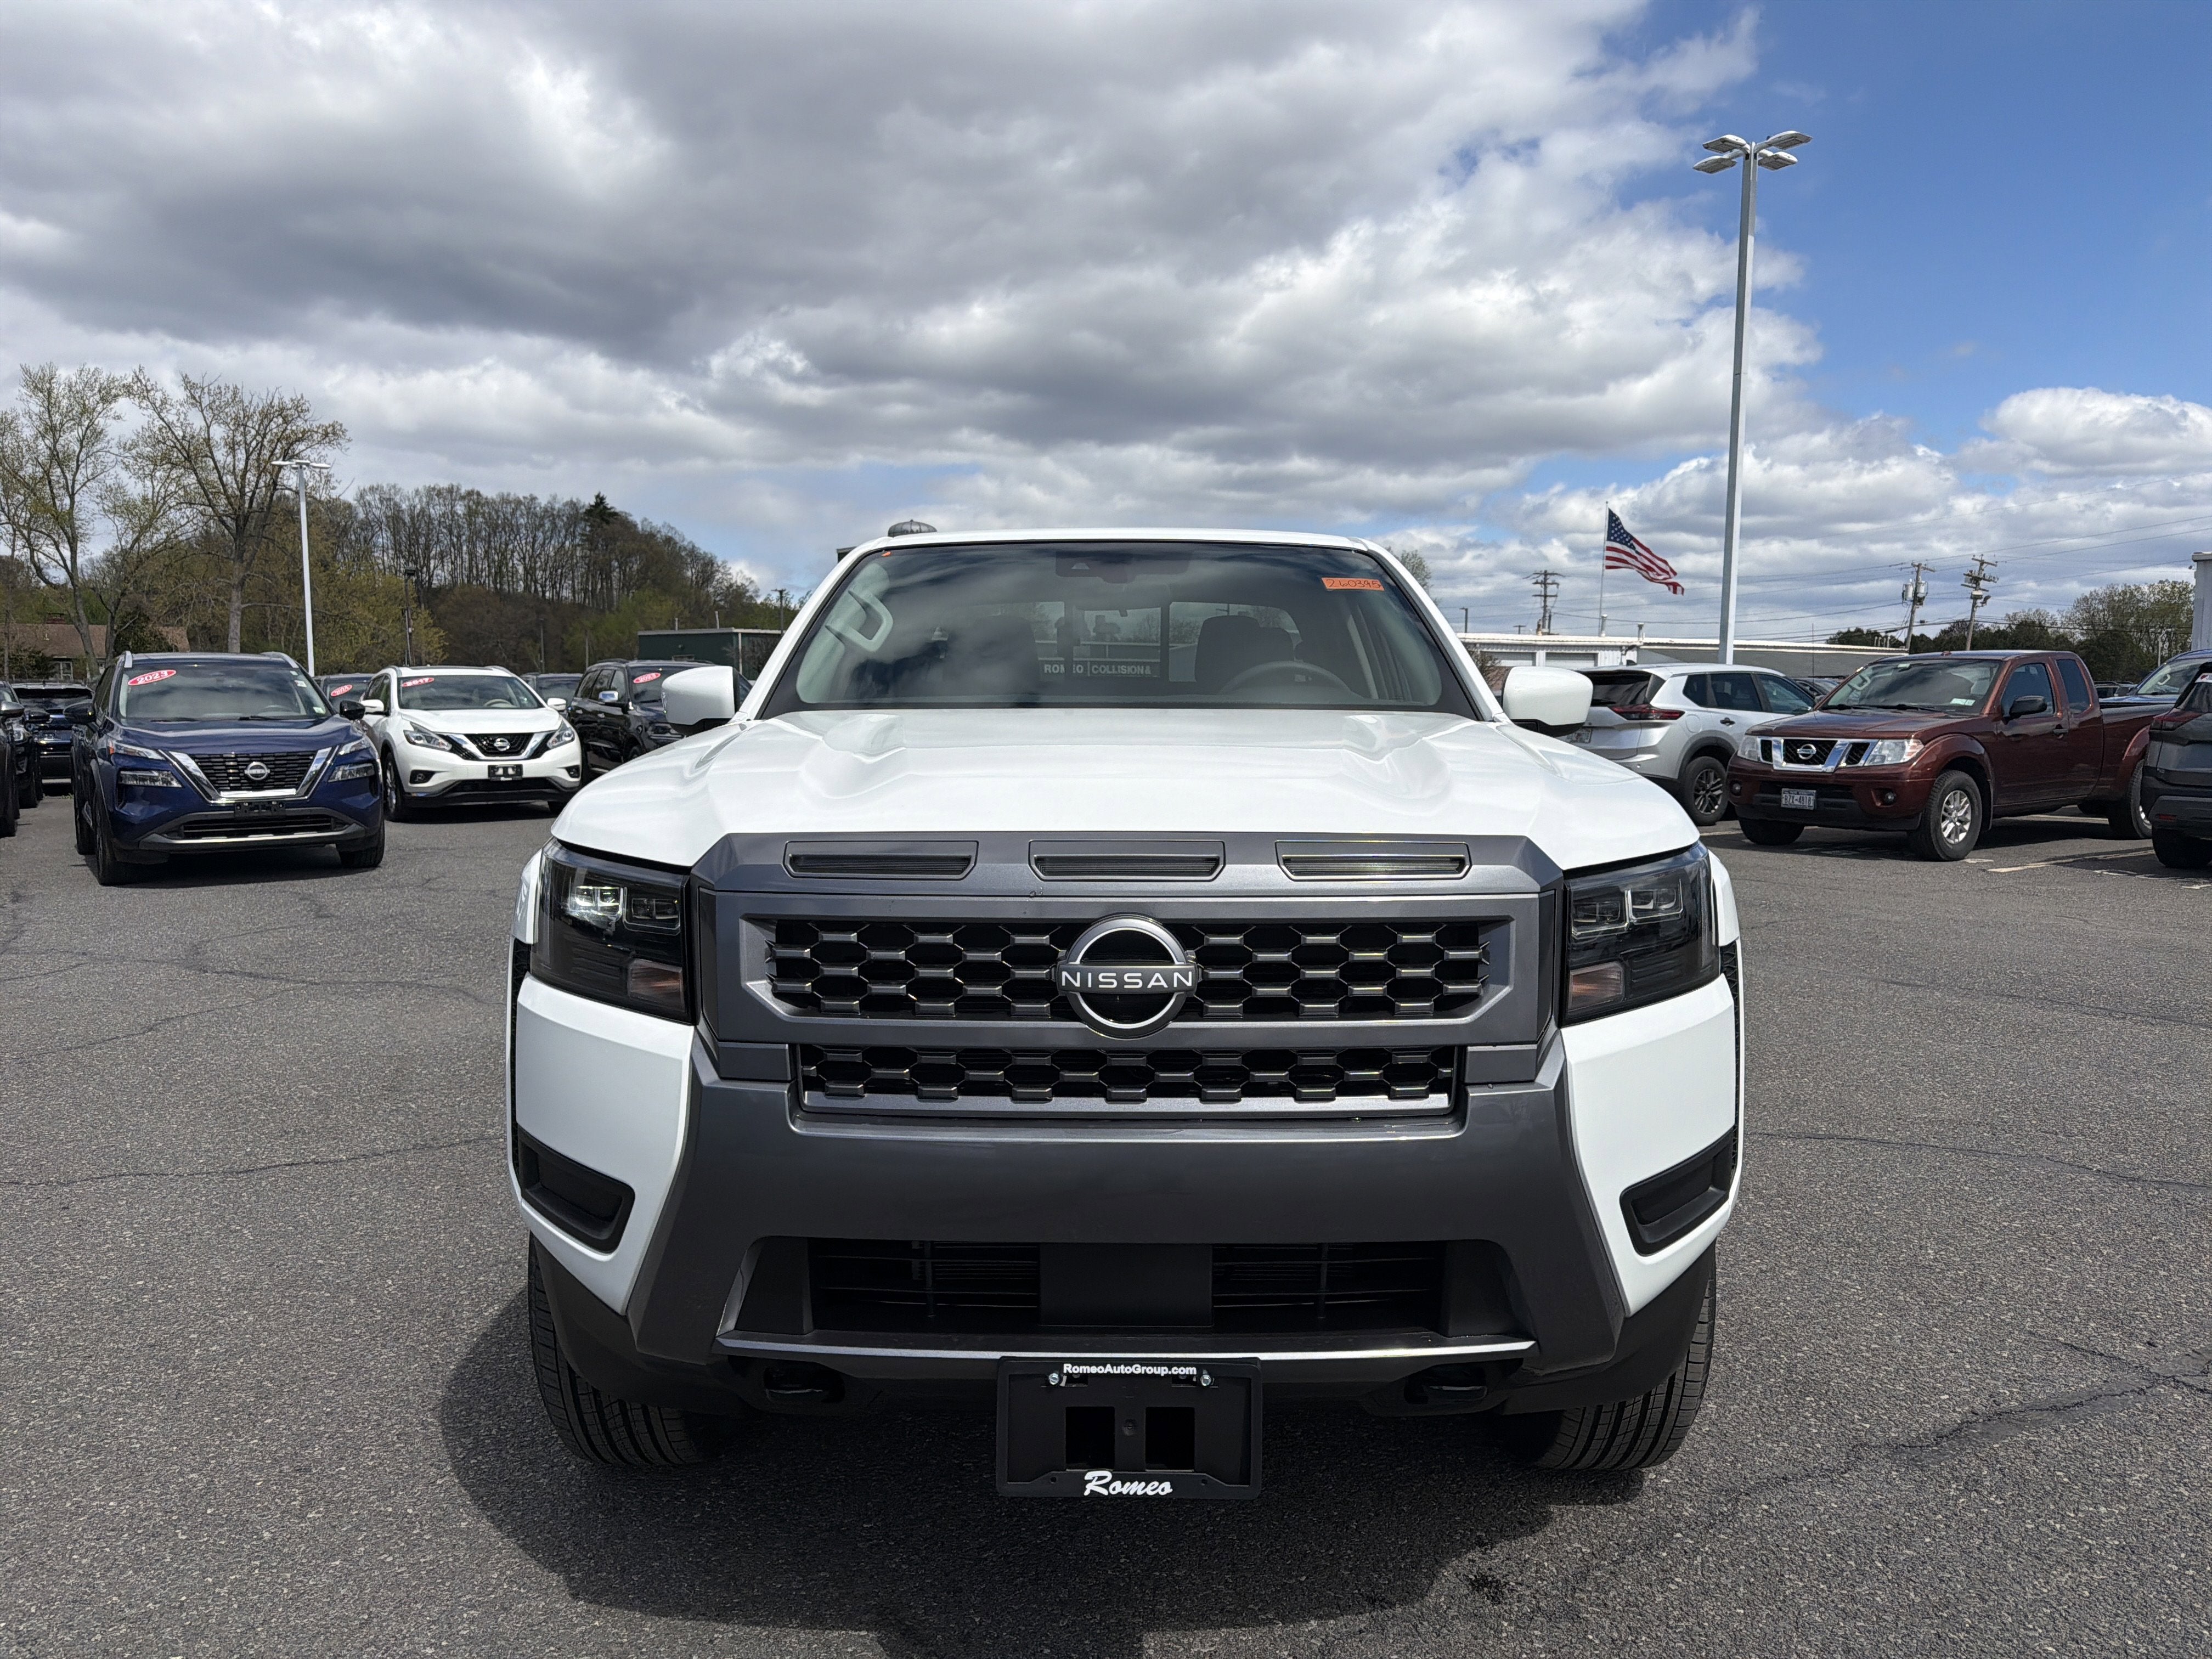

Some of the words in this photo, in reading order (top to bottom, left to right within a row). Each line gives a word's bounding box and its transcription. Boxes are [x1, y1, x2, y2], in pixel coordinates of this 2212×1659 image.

[1326, 579, 1381, 588] 260395
[137, 670, 168, 684] 2023
[1062, 971, 1192, 988] NISSAN
[1063, 1363, 1197, 1376] RomeoAutoGroup.com
[1084, 1470, 1173, 1496] Romeo
